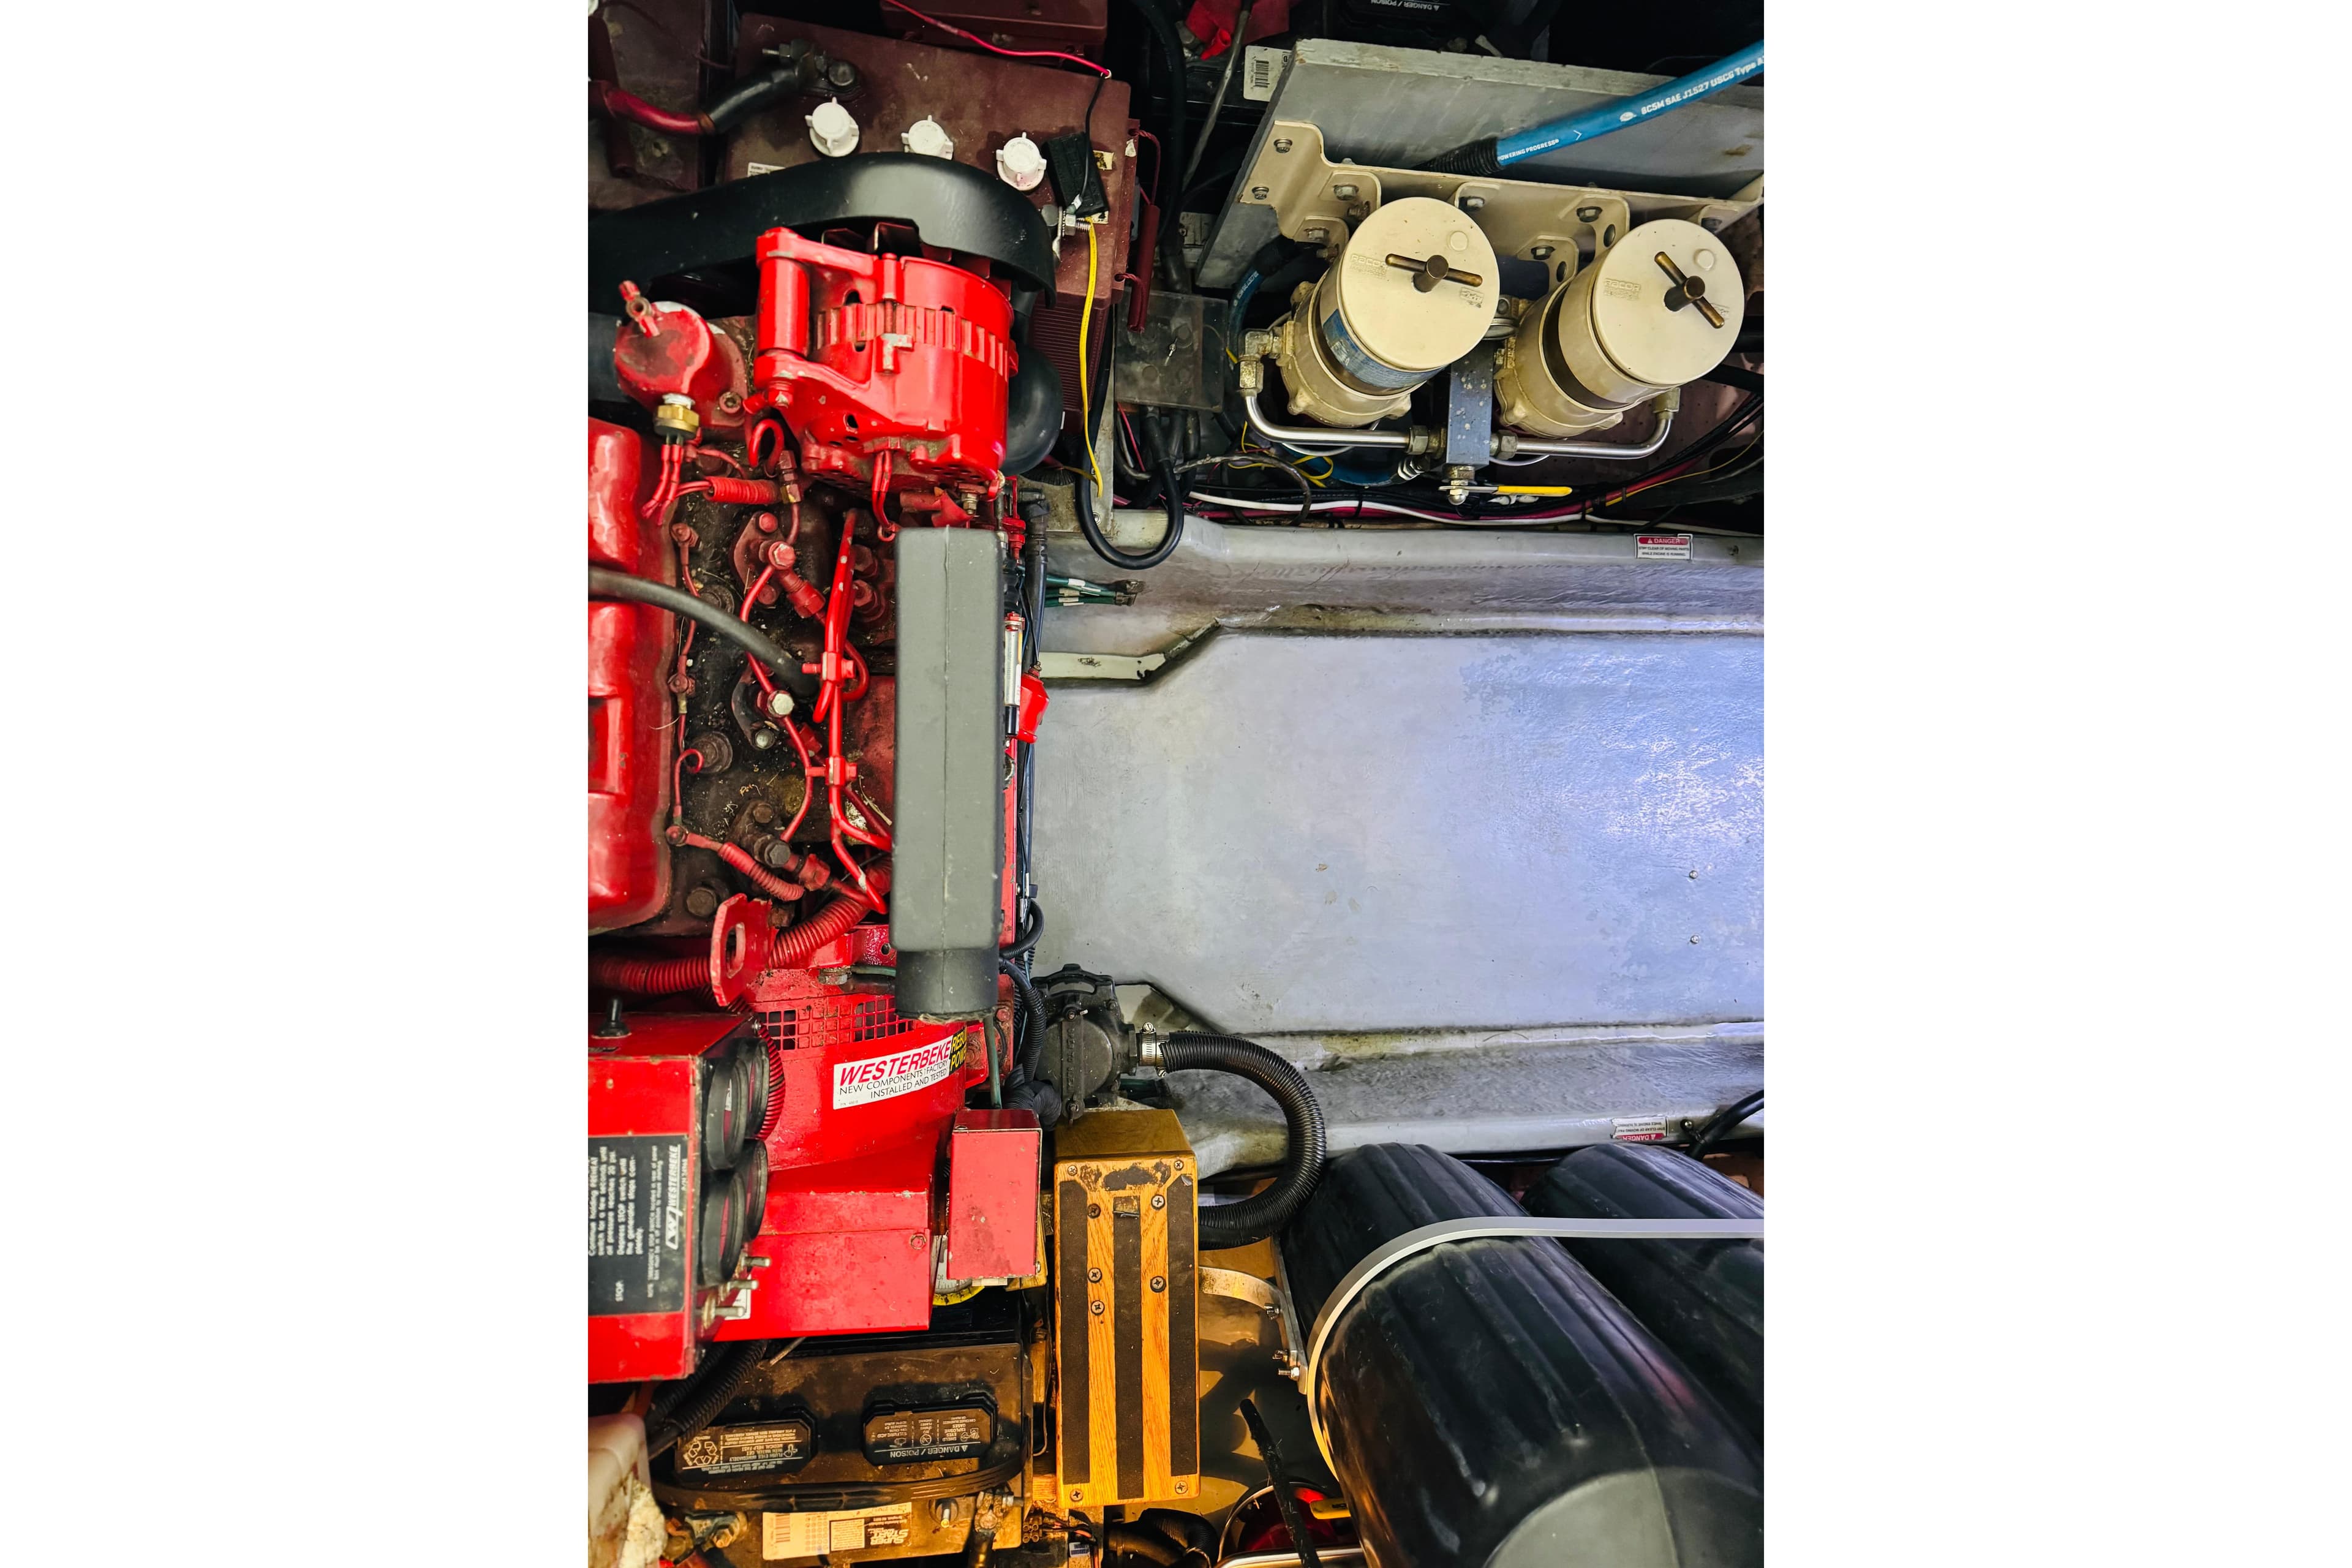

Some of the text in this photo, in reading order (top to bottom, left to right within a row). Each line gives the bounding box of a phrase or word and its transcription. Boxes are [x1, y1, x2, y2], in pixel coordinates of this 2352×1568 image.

[1665, 93, 1682, 105] SAE
[1683, 81, 1710, 101] J1527
[1711, 71, 1735, 87] USCG
[1735, 61, 1757, 77] Type
[839, 1040, 951, 1087] WESTERBEKE
[840, 1059, 948, 1095] NEW COMPONENTS FACTORY
[870, 1068, 947, 1099] INSTALLED AND TESTED
[599, 1146, 608, 1163] until
[590, 1156, 598, 1188] PREHEAT
[598, 1164, 607, 1195] seconds
[667, 1145, 678, 1207] WESTERBEKE
[589, 1190, 599, 1219] holding
[607, 1177, 616, 1209] reaches
[627, 1179, 637, 1200] stops
[617, 1158, 627, 1256] Depress STOP switch until
[627, 1202, 636, 1240] generator
[625, 1242, 634, 1256] the
[890, 1449, 919, 1458] POISON
[927, 1445, 960, 1454] DANGER
[870, 1537, 905, 1545] SUPER
[874, 1529, 910, 1539] START
